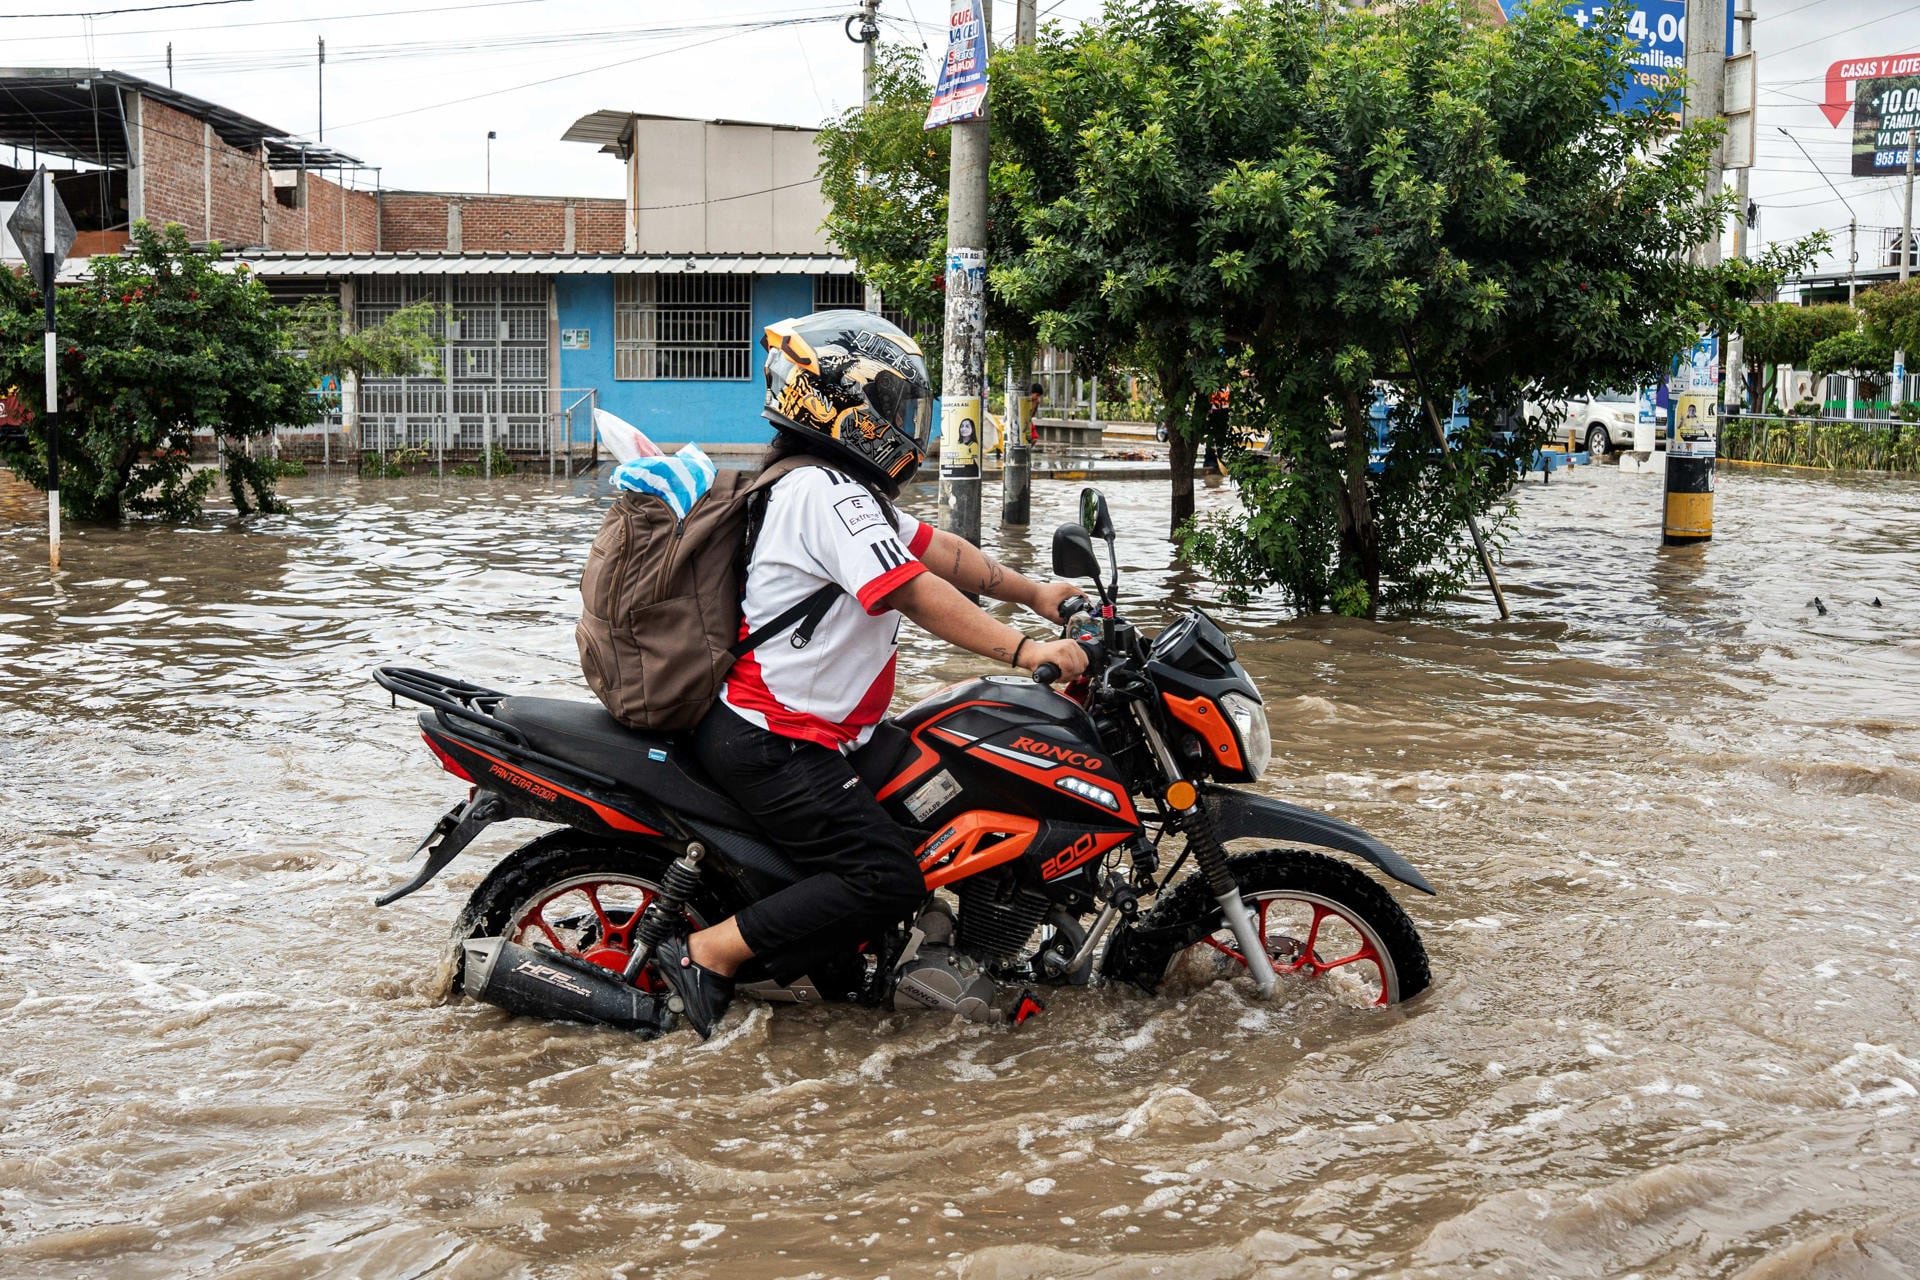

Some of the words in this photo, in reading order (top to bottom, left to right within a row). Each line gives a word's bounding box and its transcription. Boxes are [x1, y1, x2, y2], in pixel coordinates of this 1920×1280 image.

[1841, 61, 1877, 78] CASAS
[1881, 60, 1889, 75] Y
[1892, 57, 1920, 74] LOTE
[1871, 88, 1920, 114] +10,0
[1877, 132, 1891, 147] YA
[1876, 151, 1894, 166] 955
[1009, 736, 1103, 770] RONCO
[488, 764, 532, 791] PANTERA
[530, 784, 559, 802] 200R
[1041, 833, 1093, 880] 200
[905, 985, 940, 1005] RONCO
